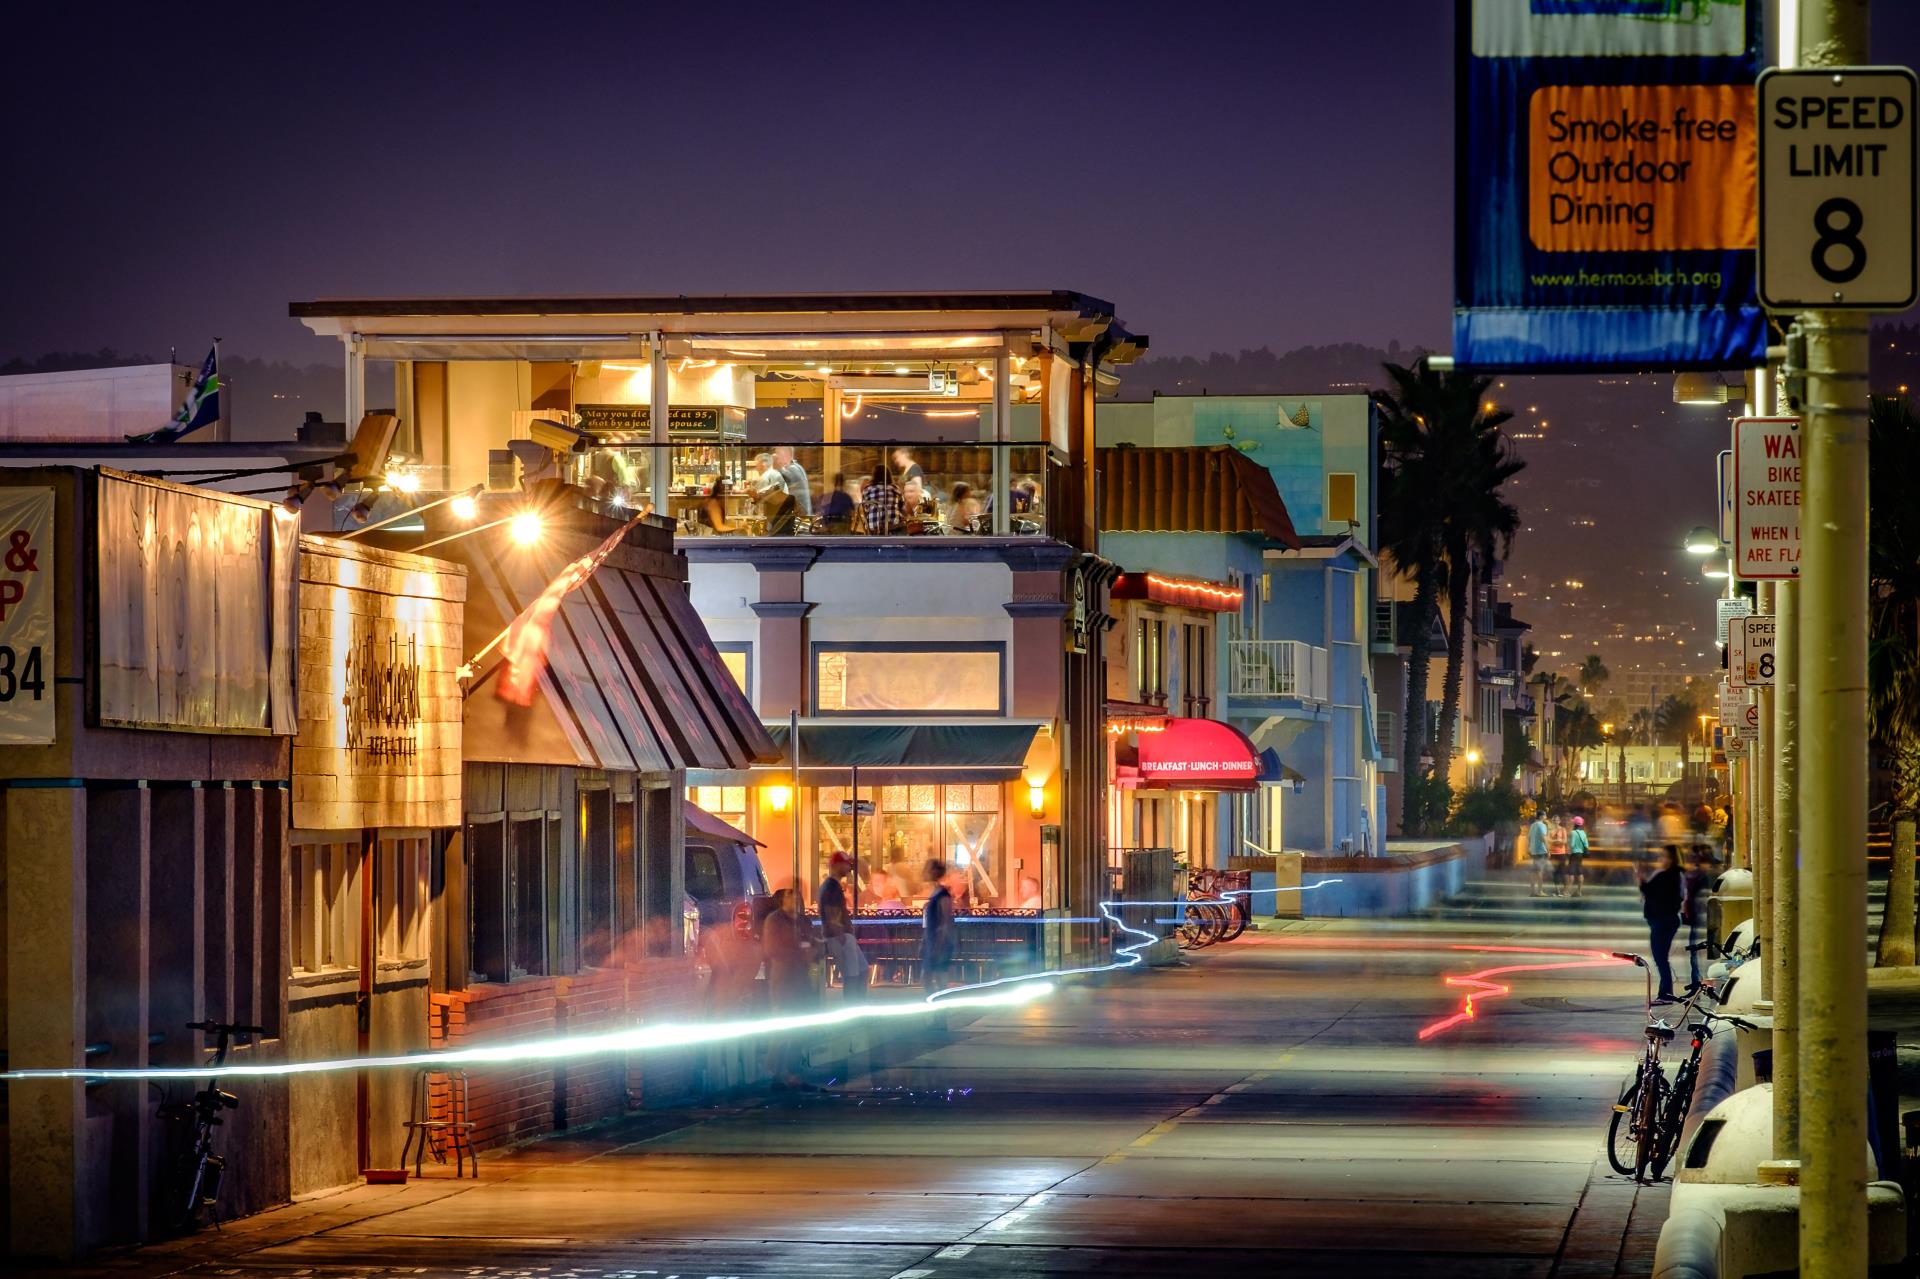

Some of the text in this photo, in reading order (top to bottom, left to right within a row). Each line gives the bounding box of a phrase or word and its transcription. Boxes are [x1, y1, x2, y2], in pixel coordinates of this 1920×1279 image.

[1773, 96, 1904, 130] SPEED
[1548, 108, 1737, 144] Smoke-free
[1548, 150, 1692, 184] Outdoor
[1789, 144, 1888, 177] LIMIT
[1549, 193, 1655, 235] Dining
[1811, 197, 1868, 284] 8
[1531, 267, 1722, 290] www.hermosabch.org
[586, 410, 608, 419] May
[611, 412, 628, 420] you
[631, 410, 647, 418] die
[695, 411, 712, 419] 95,
[588, 419, 608, 427] shot
[611, 419, 623, 428] by
[632, 419, 651, 429] jeal
[669, 421, 707, 430] spouse.
[1764, 434, 1801, 459] WA
[1751, 526, 1788, 541] WHEN
[4, 529, 40, 573] &
[1747, 548, 1801, 562] ARE FLA
[1748, 623, 1776, 634] SPEE
[1752, 637, 1775, 648] LIMI
[1759, 653, 1775, 678] 8
[1141, 760, 1253, 771] BREAKFAST LUNCH DINNER
